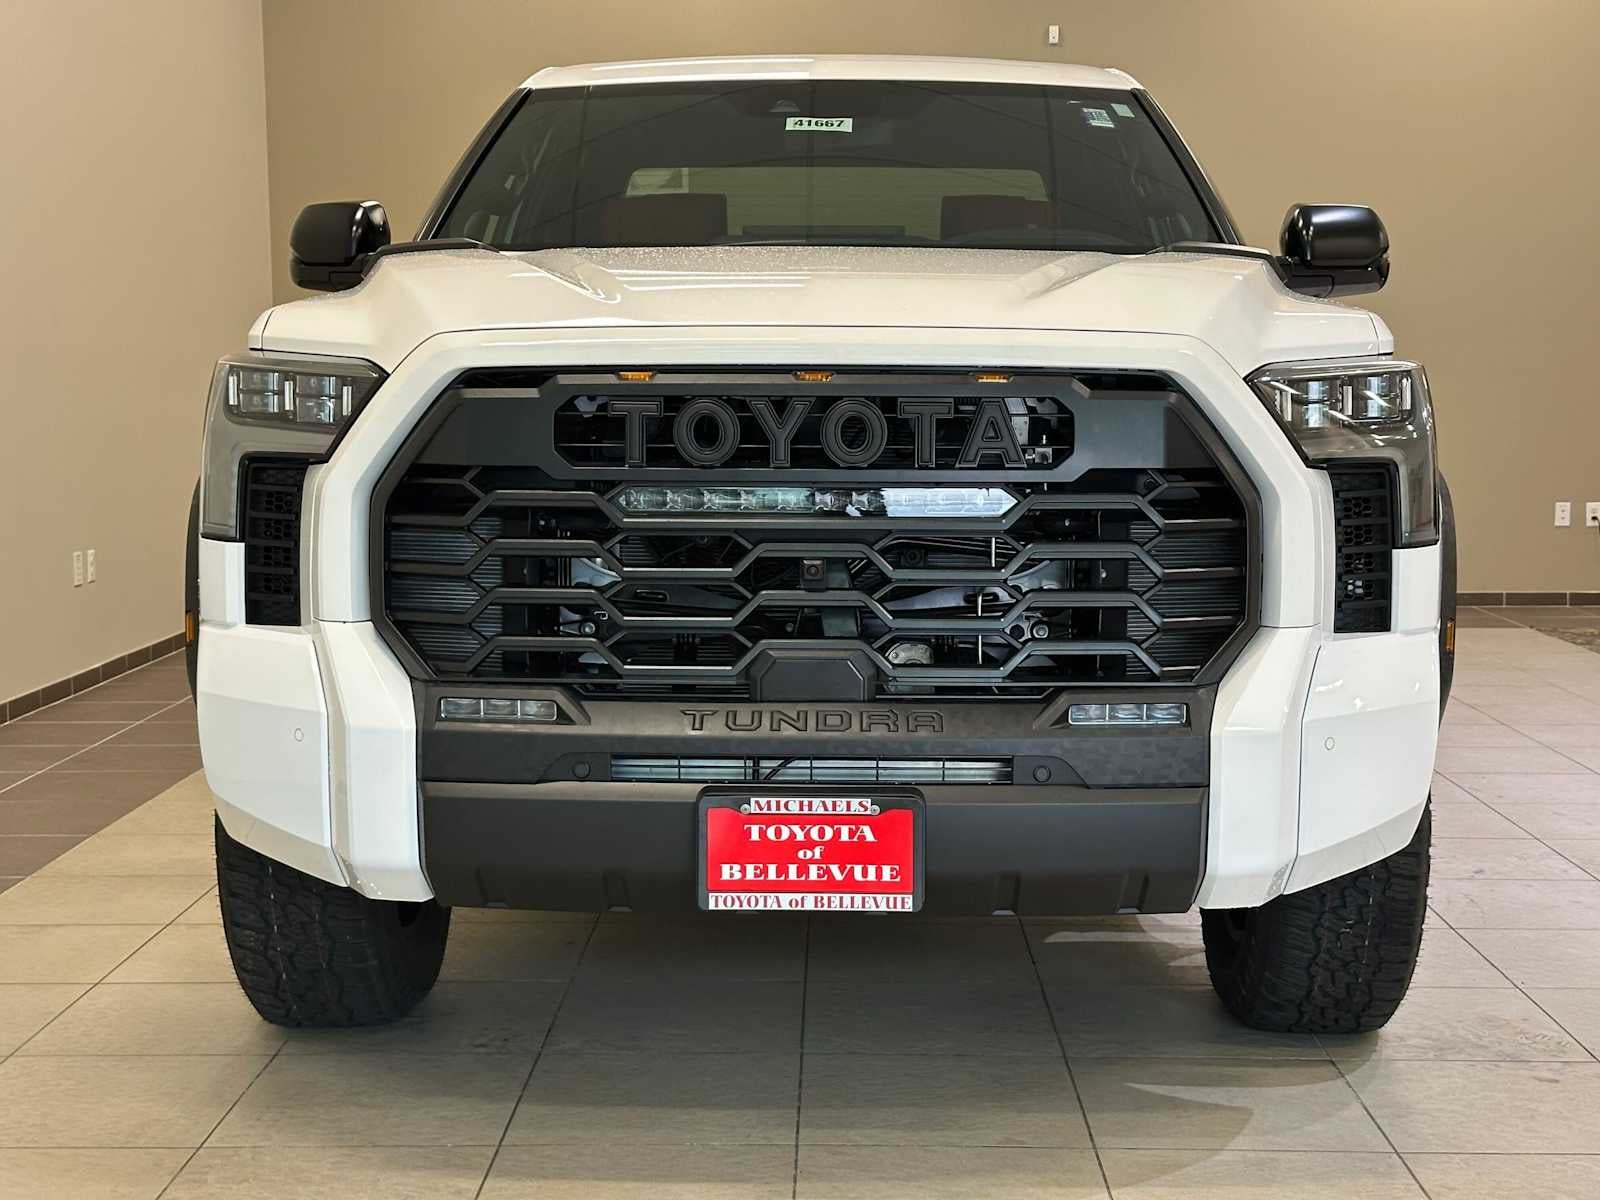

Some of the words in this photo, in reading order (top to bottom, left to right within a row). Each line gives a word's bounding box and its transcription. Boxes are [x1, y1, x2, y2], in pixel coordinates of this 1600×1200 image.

[794, 119, 845, 128] 41667
[608, 398, 1027, 468] TOYOTA
[680, 708, 945, 733] TUNDRA
[753, 799, 869, 813] MICHAELS
[744, 824, 877, 842] TOYOTA
[797, 846, 825, 860] of
[720, 863, 901, 882] BELLEVUE
[711, 894, 783, 909] TOYOTA
[788, 895, 809, 909] of
[813, 895, 911, 910] BELLEVUE
